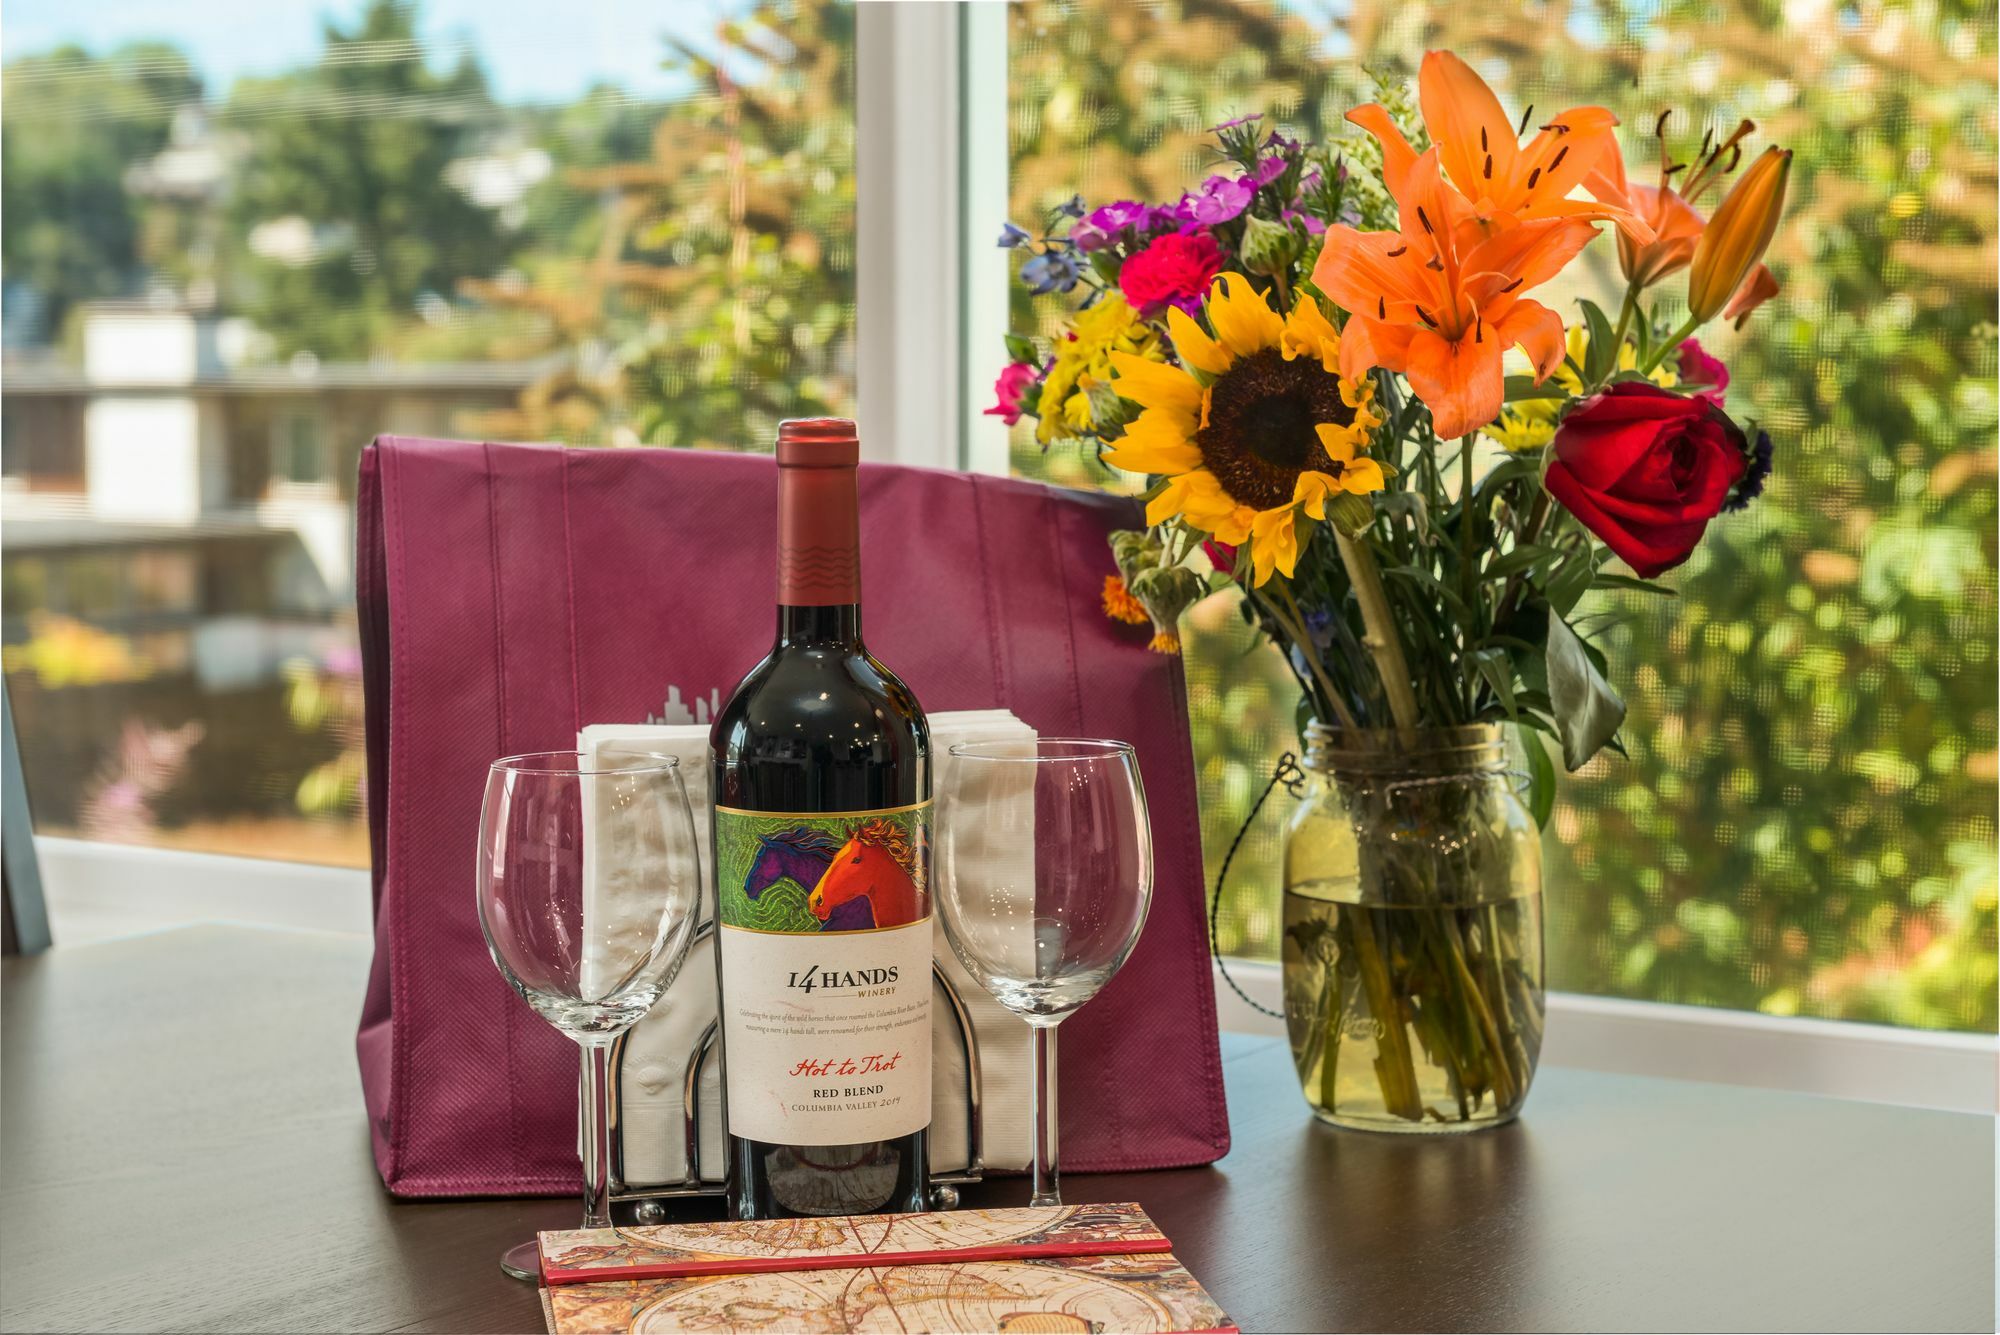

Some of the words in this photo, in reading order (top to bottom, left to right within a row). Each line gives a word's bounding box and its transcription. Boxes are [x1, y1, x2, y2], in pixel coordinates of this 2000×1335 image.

[787, 965, 819, 994] 14
[821, 966, 899, 988] HANDS
[858, 986, 897, 998] WINERY
[789, 1058, 837, 1076] Hot
[833, 1058, 858, 1075] to
[859, 1051, 902, 1074] Trot
[813, 1089, 839, 1098] RED
[844, 1084, 884, 1097] BLEND
[792, 1104, 842, 1112] COLUMBIA
[846, 1101, 878, 1110] VALLEY
